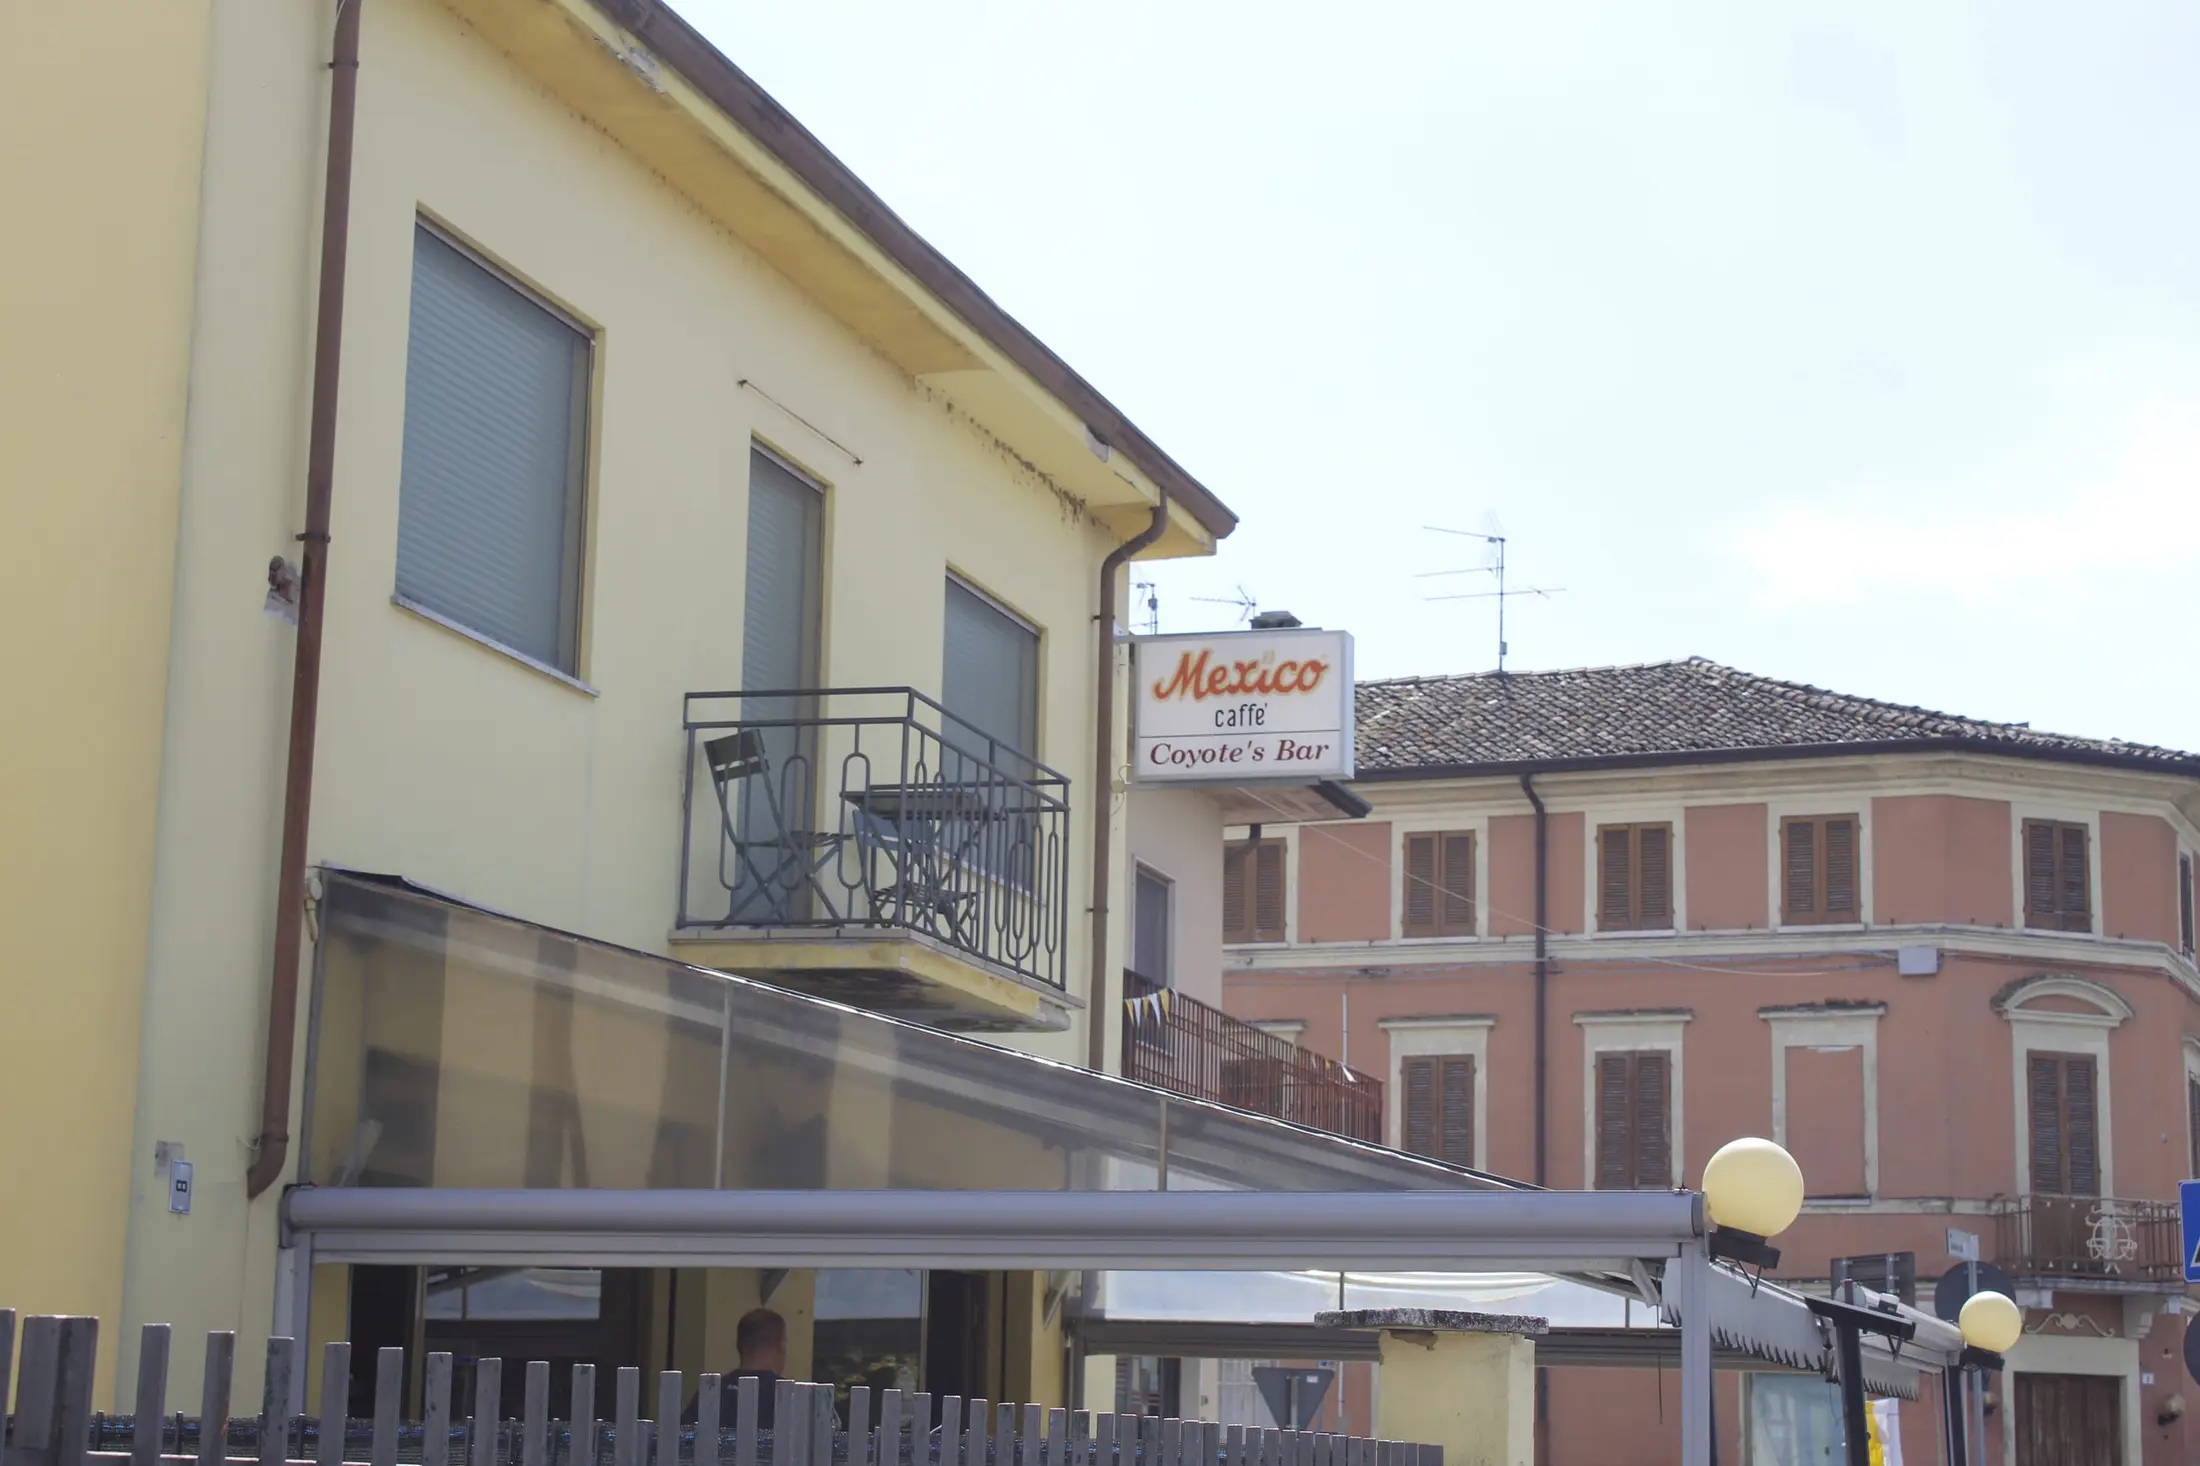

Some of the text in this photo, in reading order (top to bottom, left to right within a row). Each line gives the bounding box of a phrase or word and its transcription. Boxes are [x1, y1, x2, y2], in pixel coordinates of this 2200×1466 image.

[1152, 648, 1329, 702] Mexico
[1150, 739, 1329, 768] Coyote's Bar
